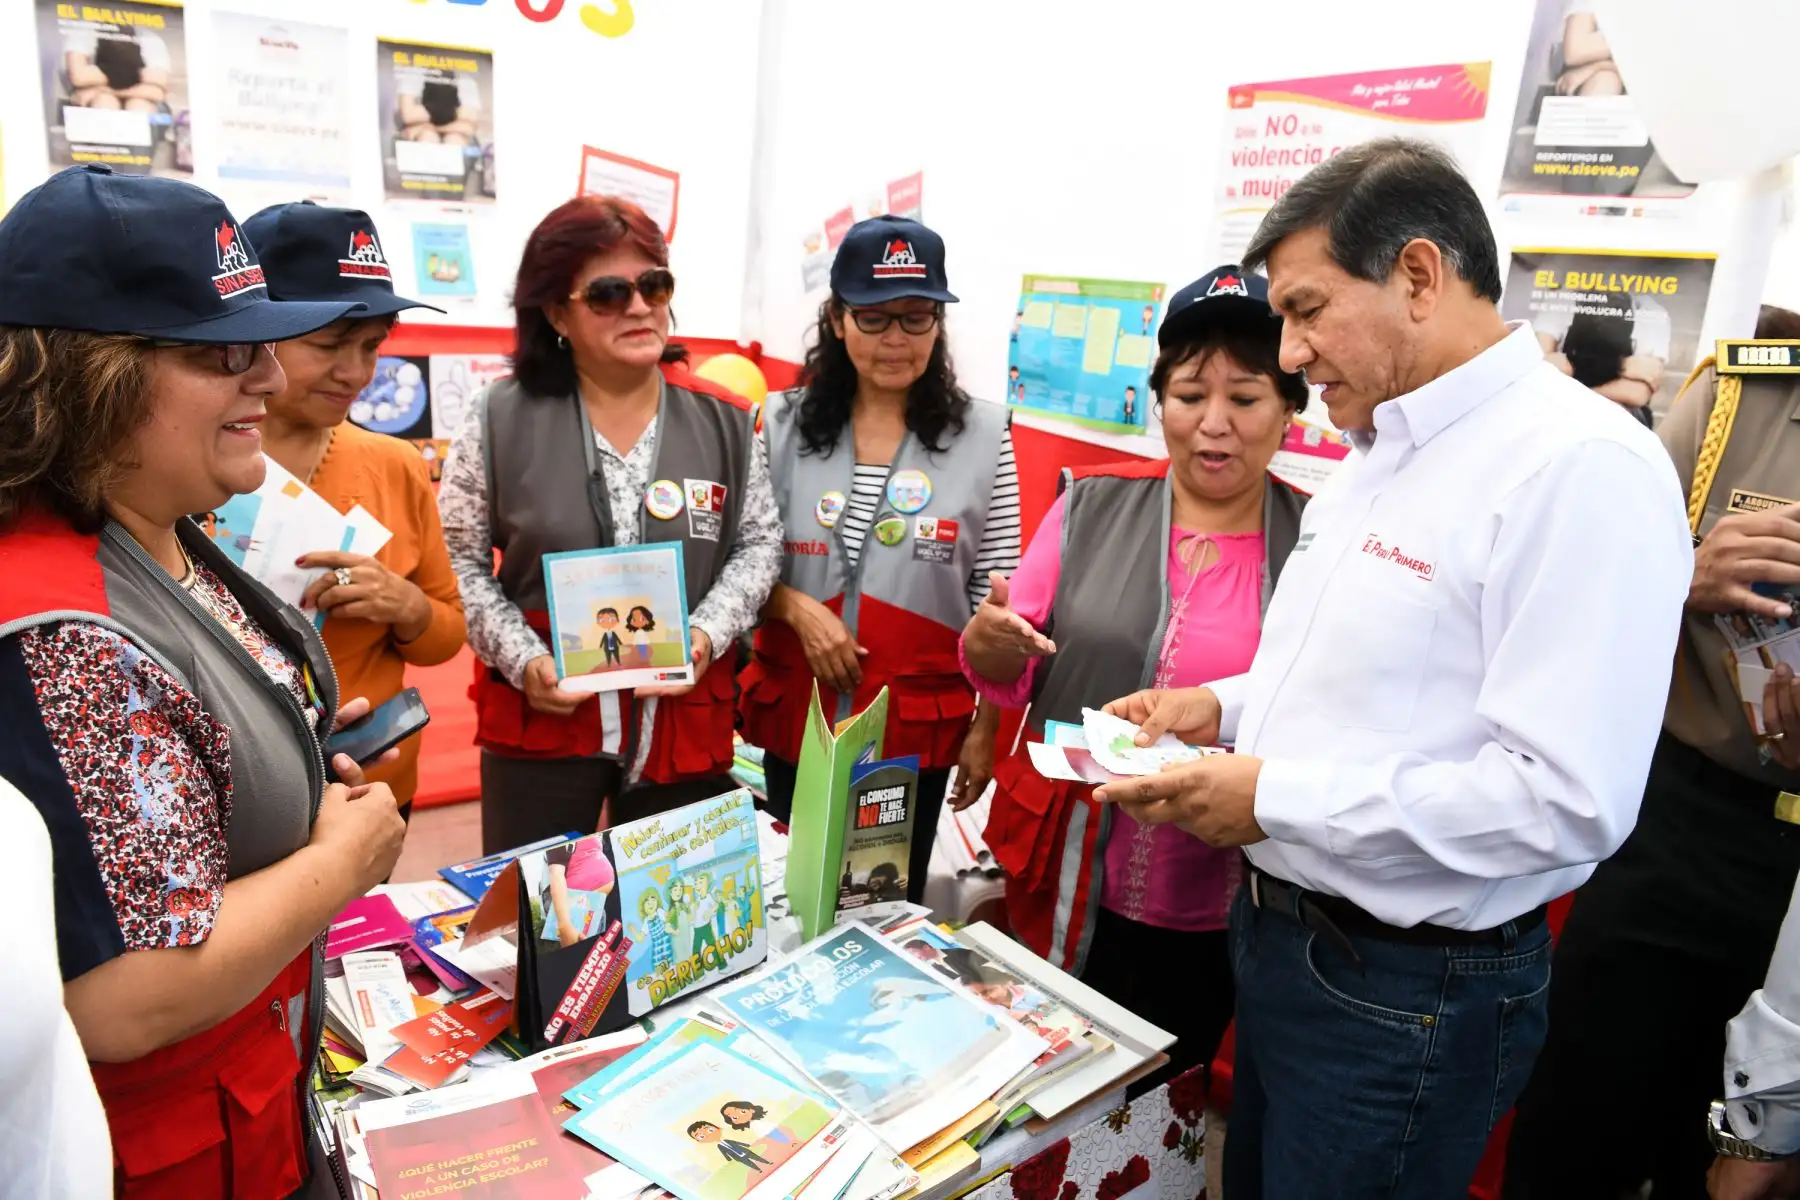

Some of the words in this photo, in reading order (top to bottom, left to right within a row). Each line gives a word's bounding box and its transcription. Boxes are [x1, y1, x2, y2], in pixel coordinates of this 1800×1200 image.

[57, 4, 78, 19] EL
[82, 6, 165, 29] BULLYING
[1265, 114, 1298, 136] NO
[1231, 144, 1323, 168] violencia
[1534, 163, 1639, 178] www.siseve.pe
[1242, 177, 1291, 200] muje
[1535, 270, 1559, 288] EL
[1565, 271, 1678, 295] BULLYING
[1558, 292, 1608, 303] PROBLEMA
[1570, 304, 1623, 317] INVOLUCRA
[1388, 547, 1432, 575] PRIMERO
[859, 795, 867, 806] EL
[867, 785, 905, 804] CONSUMO
[858, 805, 879, 828] NO
[880, 802, 887, 812] TE
[888, 799, 903, 811] HACE
[879, 808, 906, 825] FUERTE
[640, 823, 691, 859] continuar
[648, 920, 754, 1009] DERECHO!
[739, 940, 863, 1009] PROTOCOLOS
[544, 1017, 563, 1042] NO
[559, 995, 576, 1015] ES
[571, 941, 607, 993] TIEMPO
[569, 953, 611, 1020] EMBARAZO
[399, 1164, 436, 1179] ¿QUÉ
[438, 1152, 484, 1169] HACER
[487, 1137, 538, 1158] FRENTE
[425, 1176, 436, 1185] A
[438, 1170, 459, 1182] UN
[462, 1159, 500, 1176] CASO
[502, 1154, 521, 1165] DE
[400, 1178, 478, 1200] VIOLENCIA
[479, 1157, 549, 1183] ESCOLAR?
